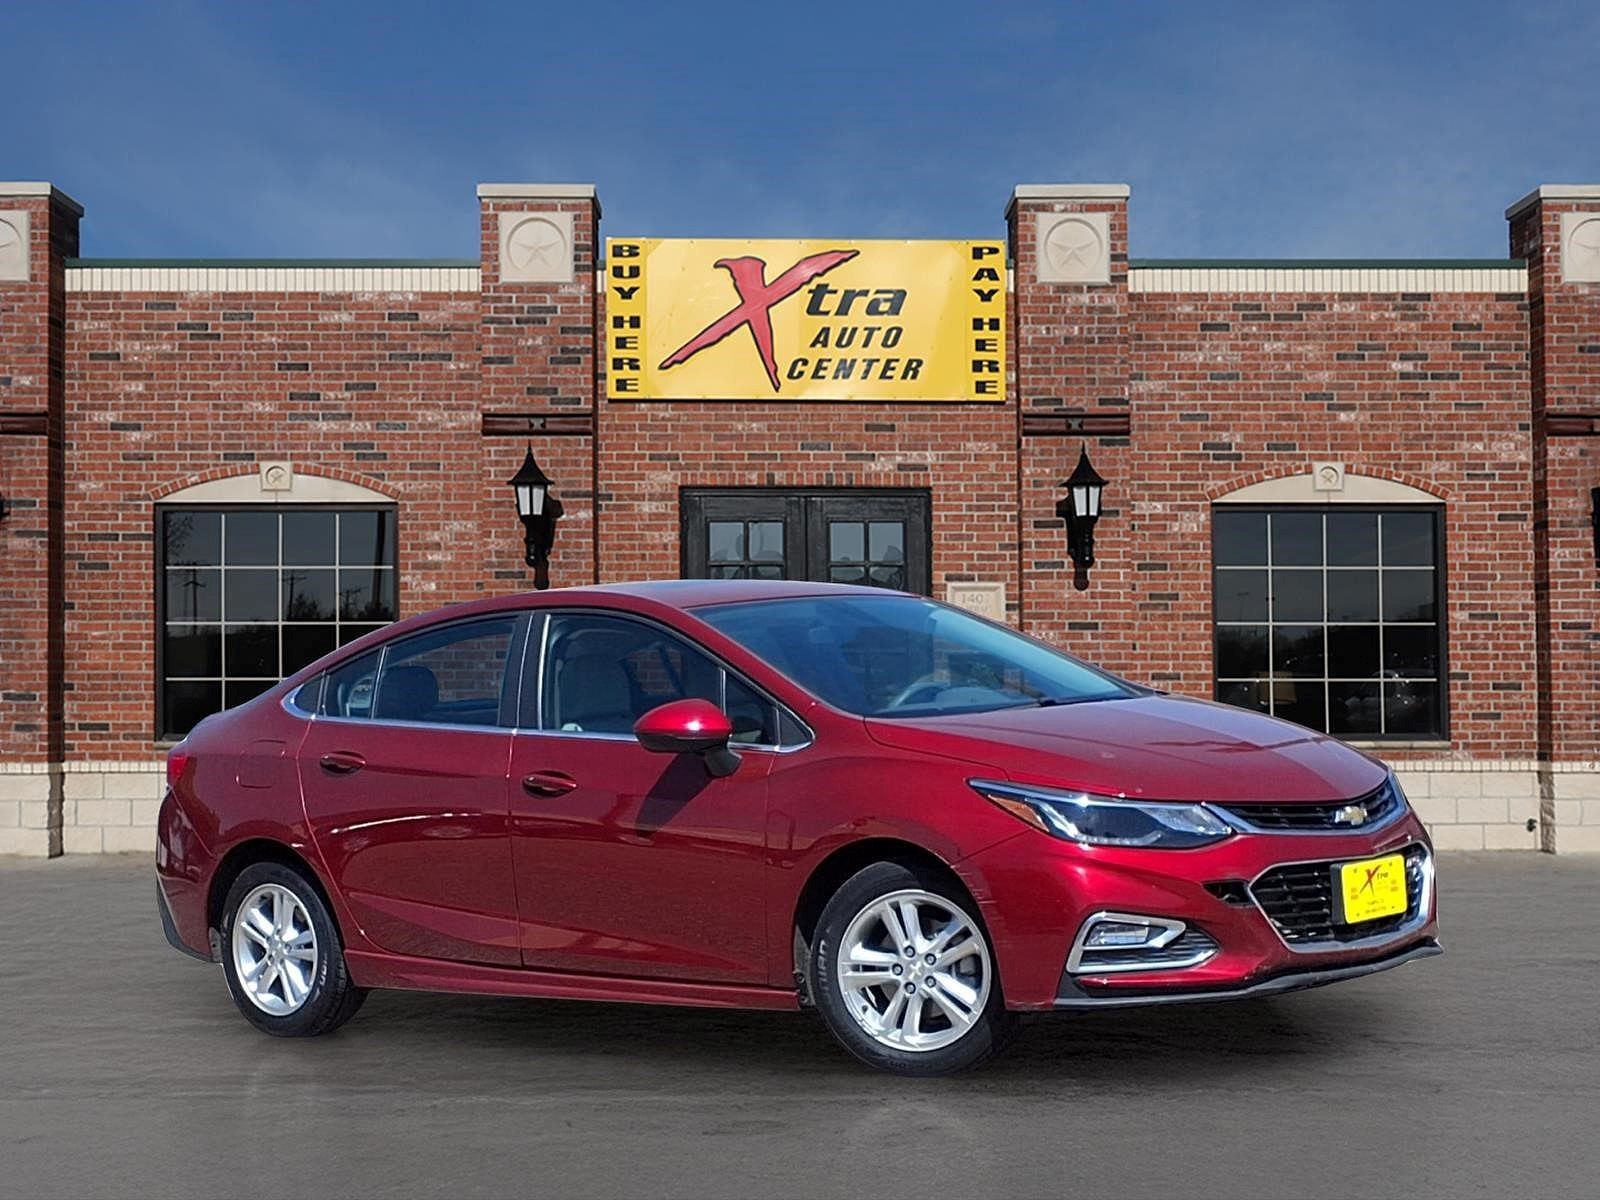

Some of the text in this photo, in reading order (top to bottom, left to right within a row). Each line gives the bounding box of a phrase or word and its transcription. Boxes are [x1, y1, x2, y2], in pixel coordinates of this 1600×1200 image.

[612, 244, 640, 392] BUY HERE
[657, 249, 907, 392] Xtra
[786, 358, 924, 380] CENTER
[809, 326, 903, 349] AUTO
[972, 246, 1000, 394] PAY HERE
